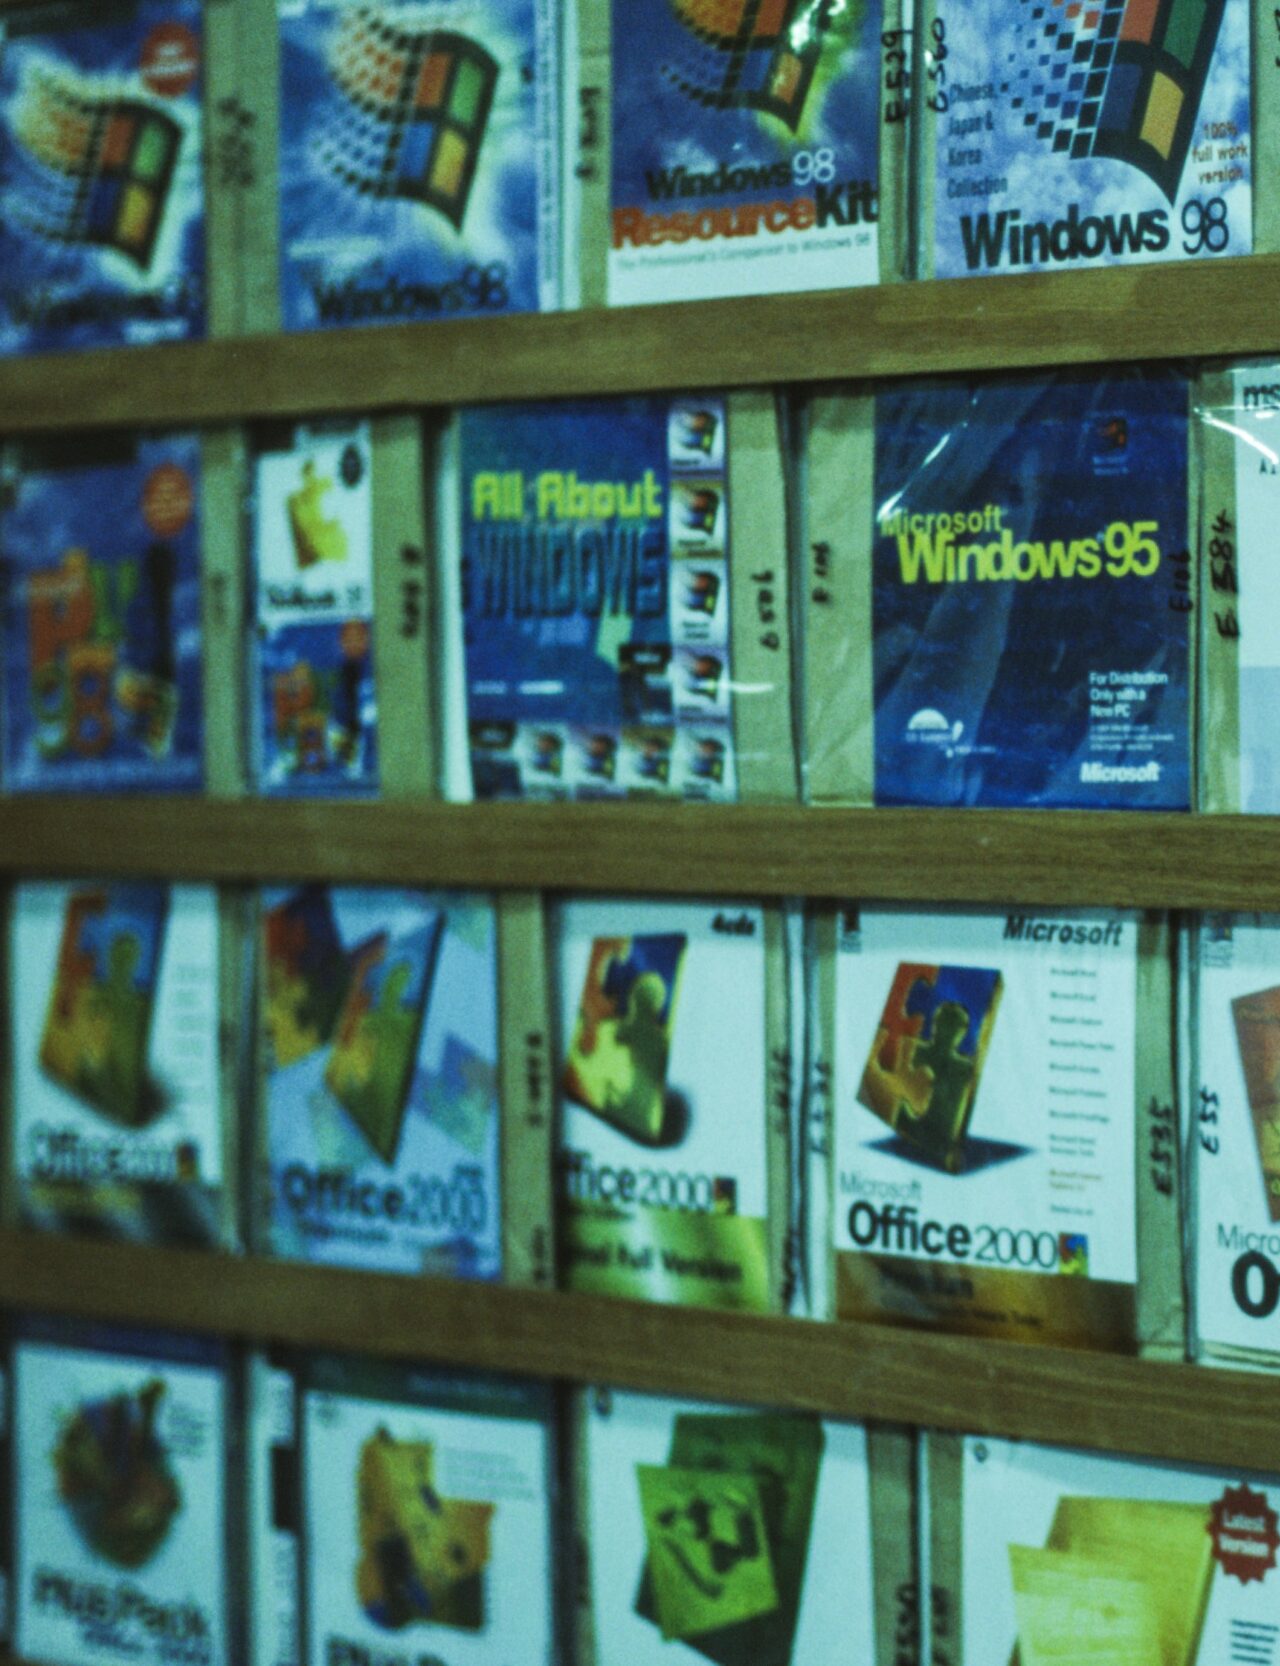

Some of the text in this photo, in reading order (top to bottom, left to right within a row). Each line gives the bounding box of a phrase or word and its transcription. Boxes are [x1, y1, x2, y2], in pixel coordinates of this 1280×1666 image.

[1216, 142, 1248, 160] work
[947, 177, 1008, 199] Collection
[960, 197, 1231, 271] Windows 98
[472, 467, 663, 521] All About
[881, 505, 1004, 538] Microsoft
[896, 520, 1161, 584] Windows 95
[1089, 670, 1169, 687] For Distribution
[1080, 760, 1161, 783] Microsoft
[1003, 916, 1123, 947] Microsoft
[839, 1171, 922, 1202] Microsoft
[848, 1200, 1060, 1270] Office 2000
